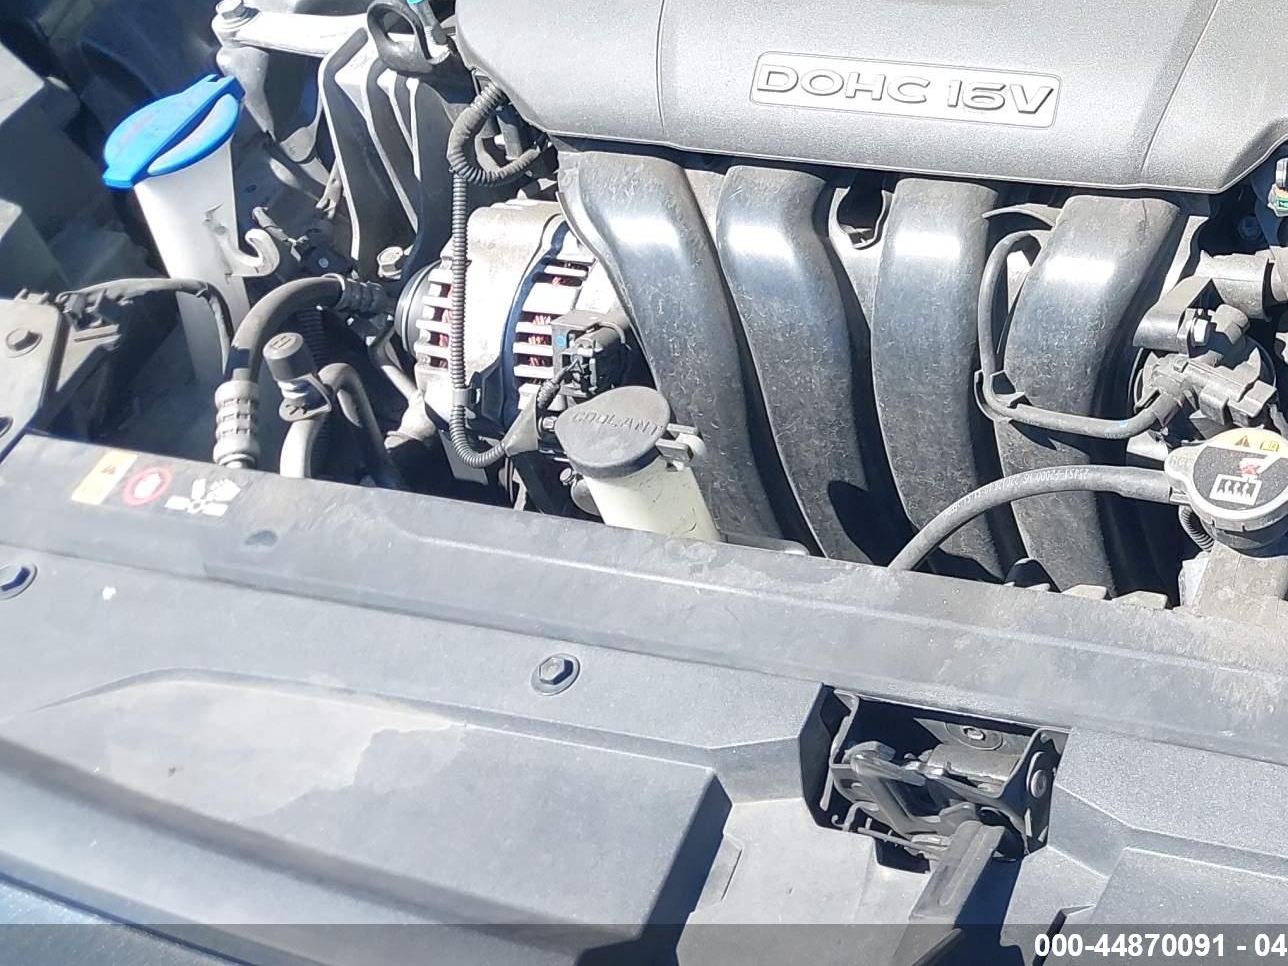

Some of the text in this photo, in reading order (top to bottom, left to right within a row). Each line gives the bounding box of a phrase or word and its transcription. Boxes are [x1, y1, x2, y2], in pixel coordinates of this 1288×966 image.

[757, 64, 1055, 115] DOHC 16V
[572, 410, 663, 436] COOLANT
